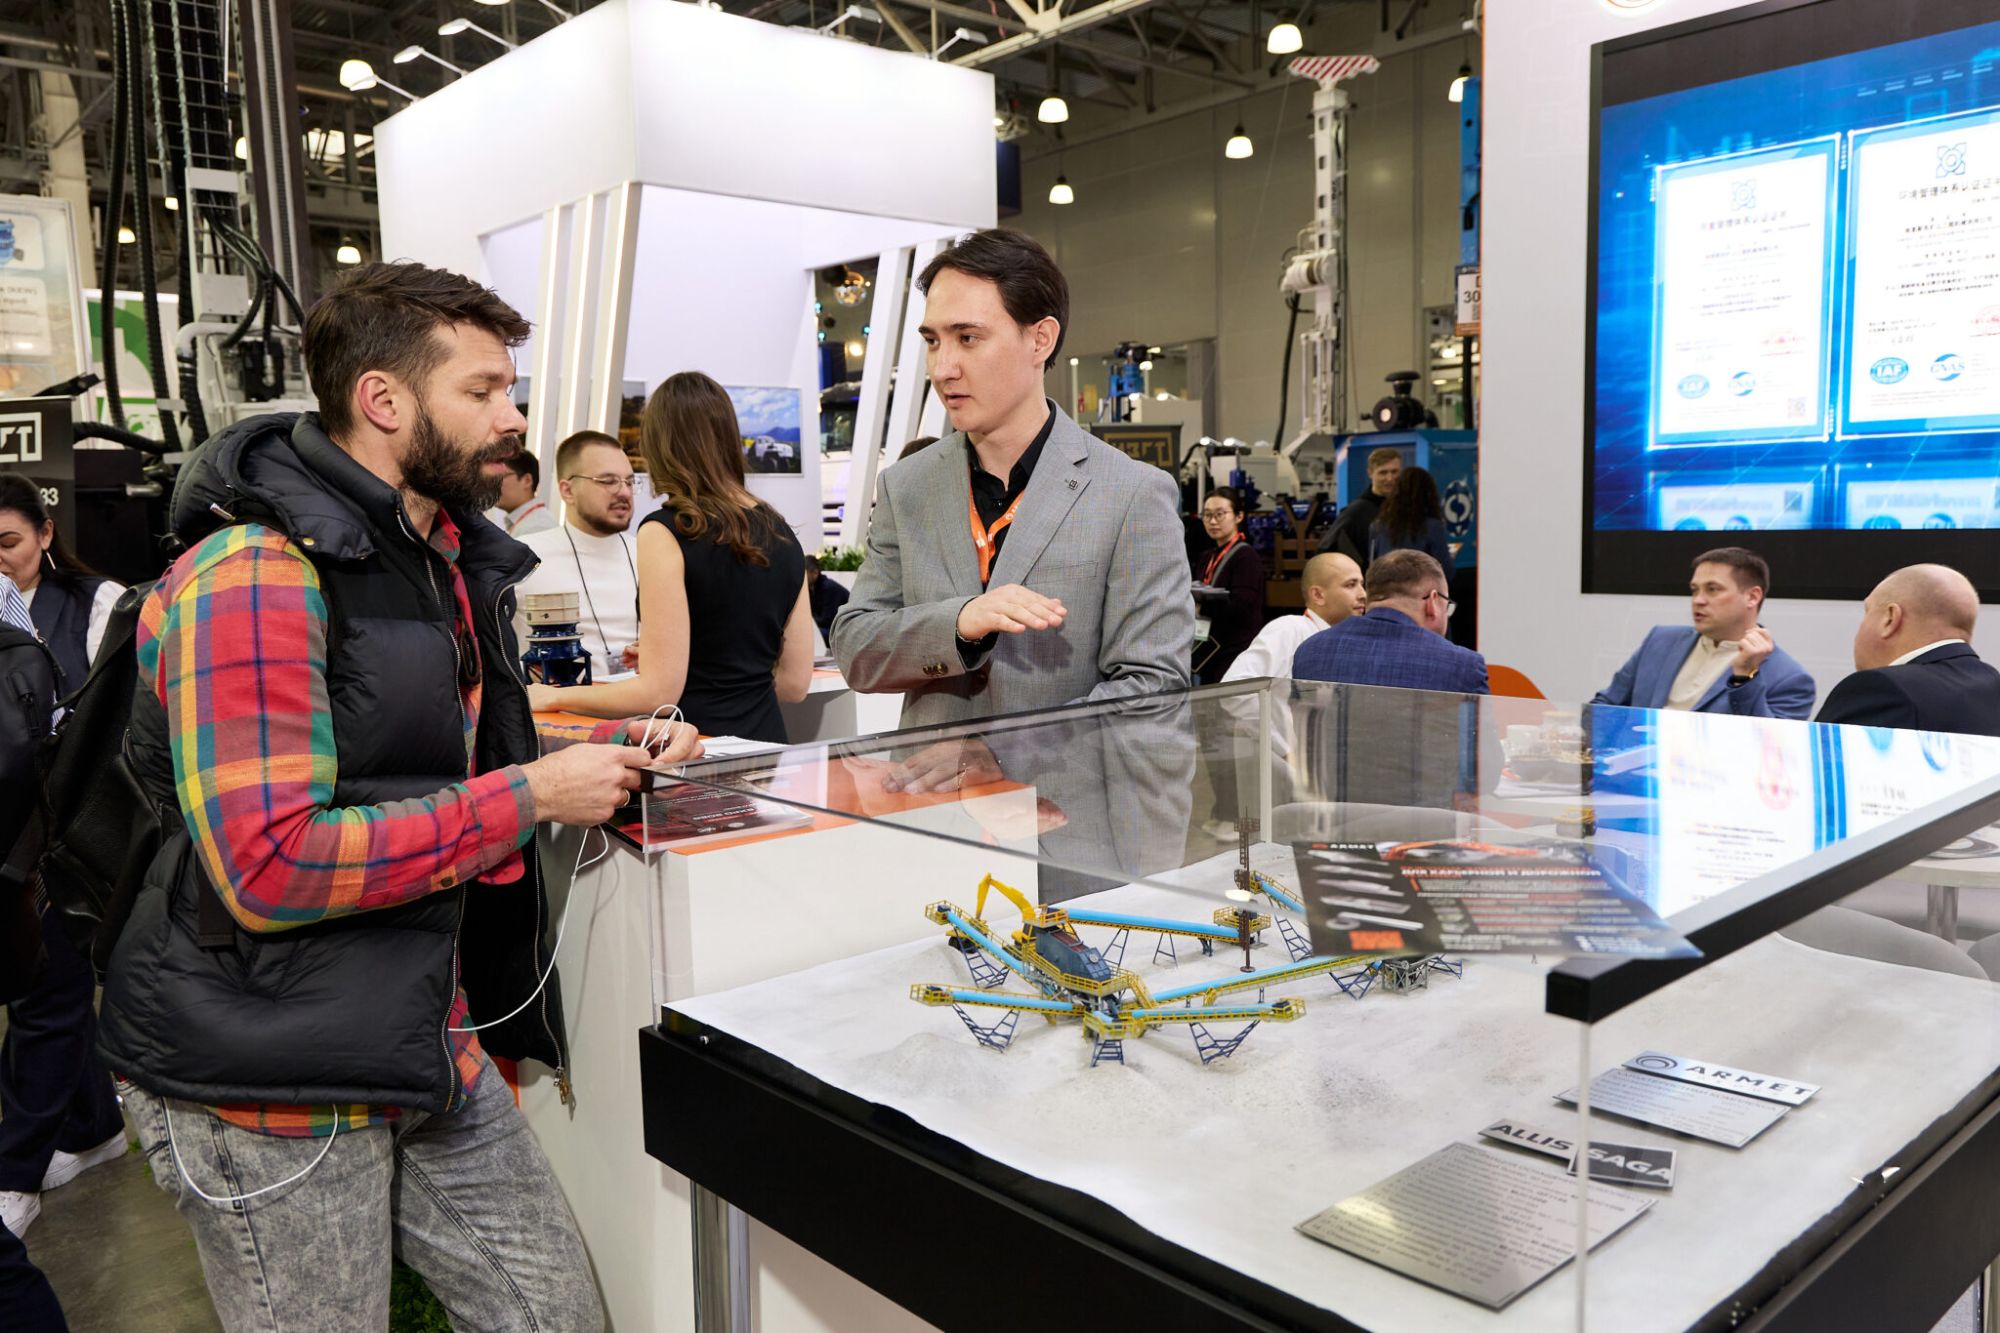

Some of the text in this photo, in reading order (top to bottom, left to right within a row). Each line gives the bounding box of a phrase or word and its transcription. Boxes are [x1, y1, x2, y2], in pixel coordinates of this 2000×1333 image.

[1684, 1065, 1812, 1096] ARMET
[1490, 1124, 1573, 1151] ALLIS
[1588, 1148, 1671, 1181] SAGA
